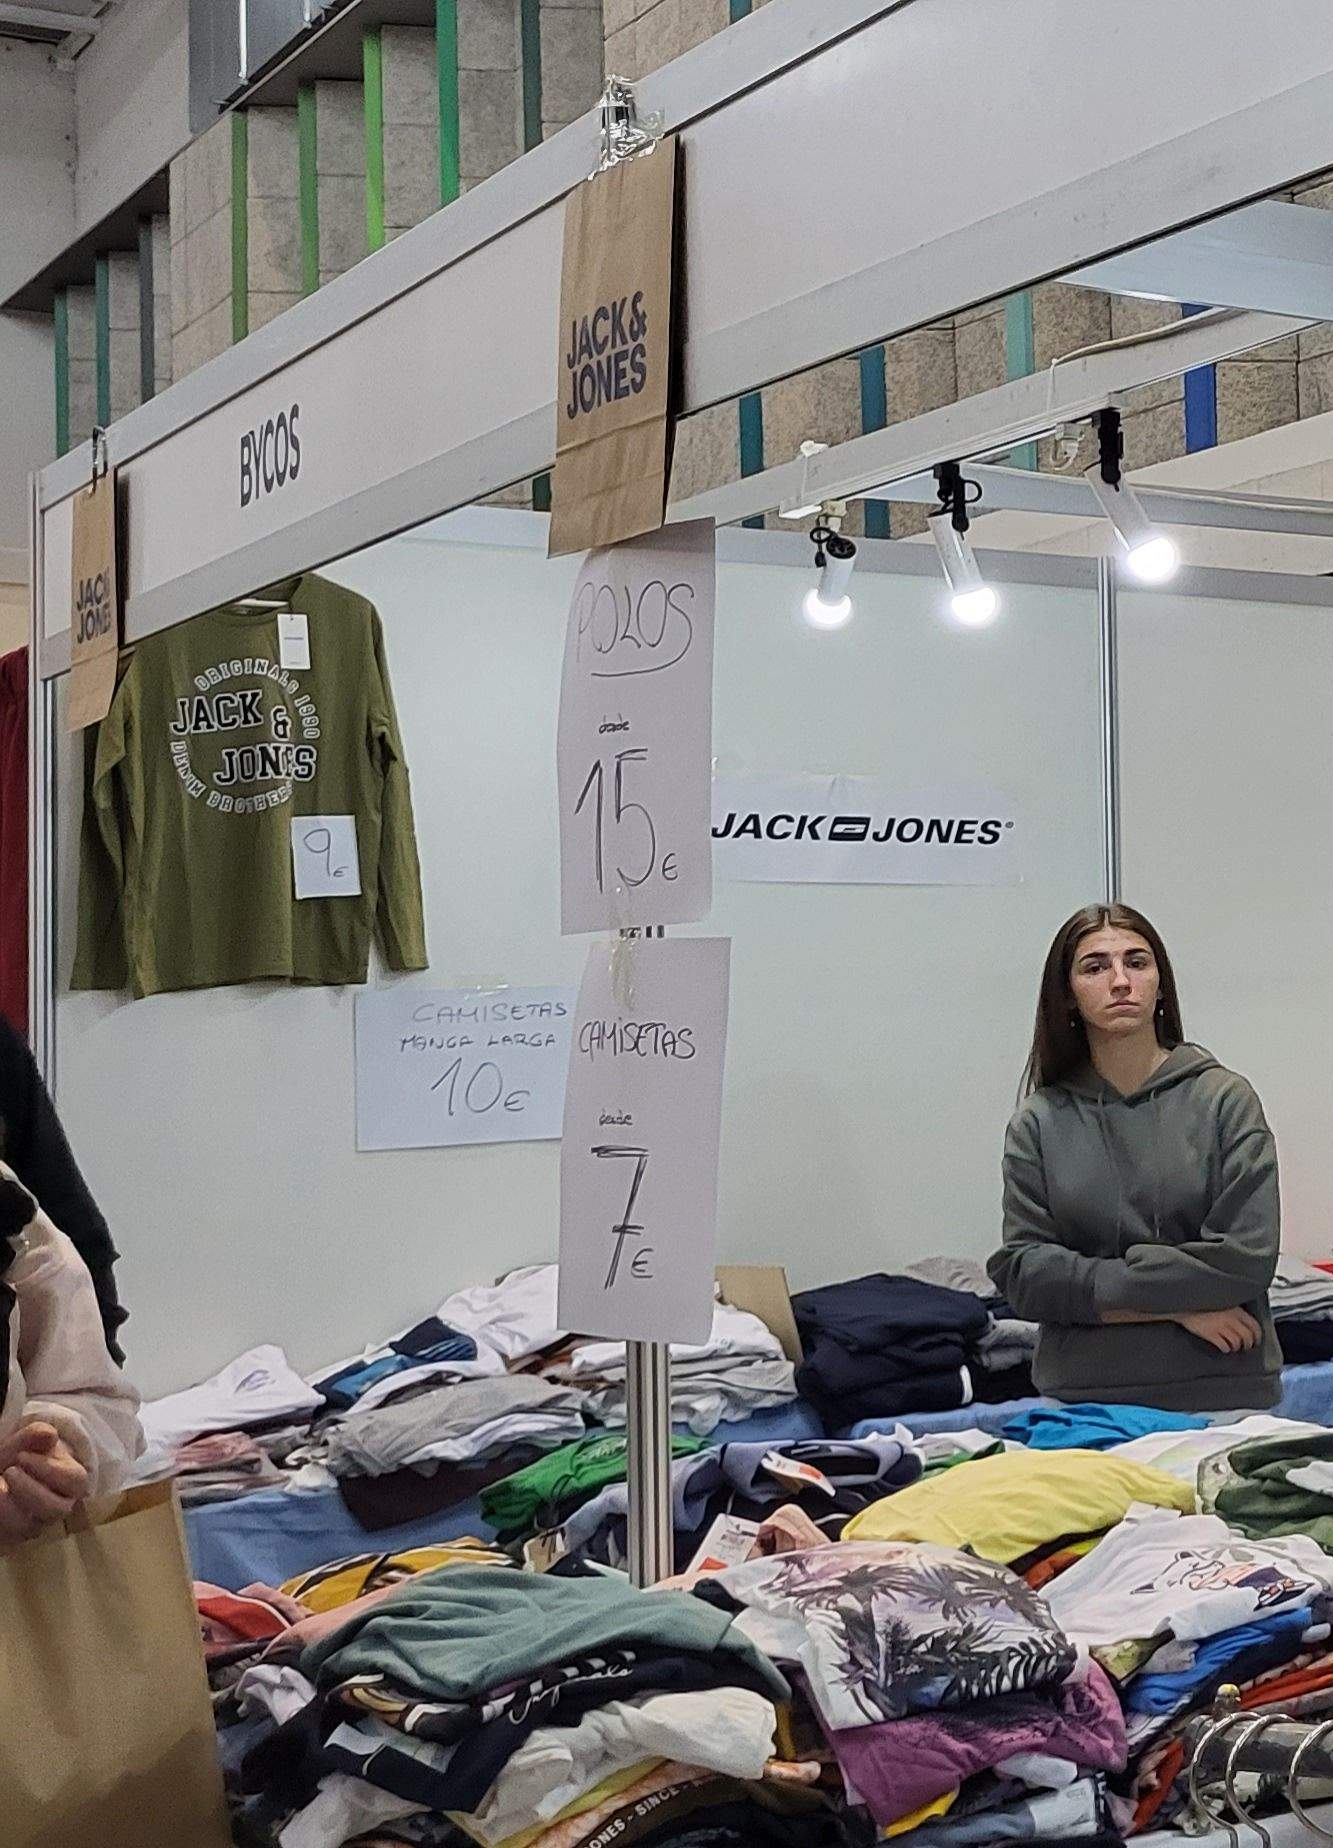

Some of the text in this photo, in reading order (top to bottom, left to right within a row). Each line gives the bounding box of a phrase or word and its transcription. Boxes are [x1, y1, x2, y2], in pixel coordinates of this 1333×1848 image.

[567, 291, 647, 369] JACK&
[567, 343, 647, 419] JONES
[240, 403, 300, 508] BYCOS
[576, 580, 694, 677] POLOS
[170, 689, 292, 741] JACK &
[194, 658, 321, 740] ORIGINALS 1990
[170, 740, 207, 798] DENIM
[574, 748, 679, 895] 15€
[711, 813, 828, 841] JACK
[303, 828, 348, 878] 9€
[401, 1033, 558, 1052] MANGA LARGA
[412, 1002, 568, 1024] CAMISETAS
[578, 1017, 697, 1060] CAMISETAS
[431, 1057, 531, 1117] 10€
[590, 1145, 654, 1291] 7€
[583, 1818, 627, 1848] ONES
